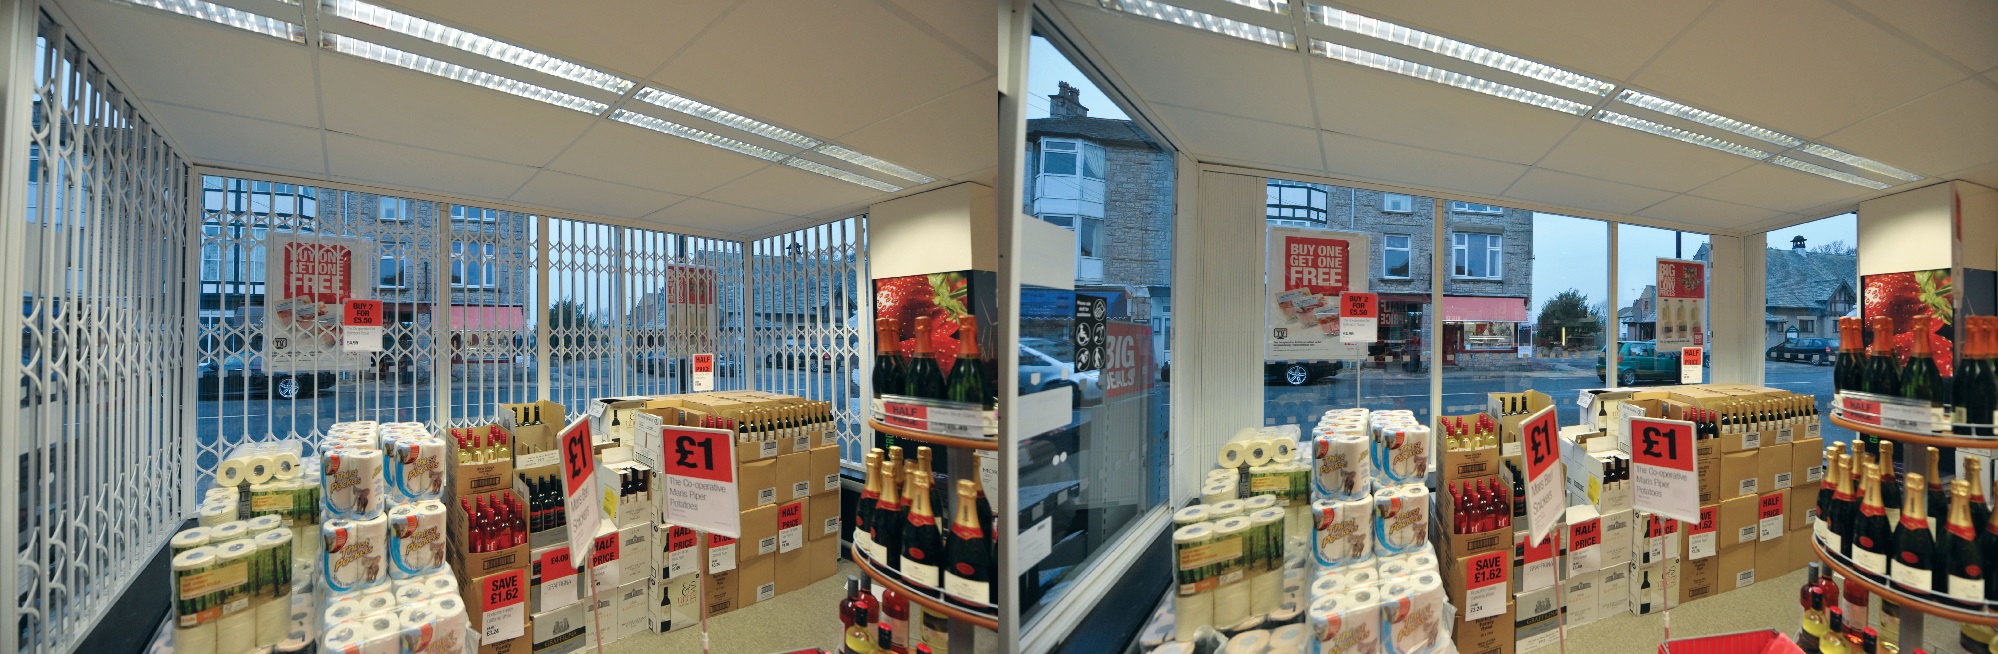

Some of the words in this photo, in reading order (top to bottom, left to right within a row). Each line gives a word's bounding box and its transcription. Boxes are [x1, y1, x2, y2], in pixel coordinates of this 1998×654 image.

[1290, 243, 1316, 255] BUY
[1317, 245, 1343, 257] ONE
[1289, 255, 1315, 267] GET
[1317, 257, 1343, 268] ONE
[1659, 262, 1676, 277] BIG
[290, 274, 344, 294] FREE
[1290, 267, 1343, 287] FREE
[1659, 280, 1676, 291] LOW
[1105, 335, 1136, 370] BIG
[1684, 349, 1700, 357] HALF
[893, 405, 918, 416] HALF
[1849, 401, 1872, 412] HALF
[1531, 420, 1551, 466] £1
[1642, 426, 1677, 460] £1
[569, 429, 587, 480] £1
[675, 435, 714, 471] £1
[1636, 465, 1648, 474] The
[1648, 467, 1688, 481] Co-operative
[669, 476, 682, 486] The
[683, 478, 726, 493] Co-operative
[1636, 475, 1653, 485] Maris
[1653, 478, 1670, 489] Piper
[669, 487, 688, 498] Maris
[689, 490, 707, 501] Piper
[1636, 486, 1662, 498] Potatoes
[670, 498, 699, 512] Potatoes
[1533, 490, 1553, 515] Snickers
[1762, 496, 1780, 508] HALF
[781, 506, 799, 517] HALF
[1763, 508, 1780, 518] PRICE
[782, 519, 799, 529] PRICE
[1575, 522, 1597, 536] HALF
[673, 538, 693, 551] PRICE
[1575, 536, 1597, 550] PRICE
[550, 553, 569, 565] £4.09
[593, 552, 615, 567] PRICE
[1475, 556, 1501, 571] SAVE
[1474, 568, 1502, 583] £1.62
[491, 575, 518, 592] SAVE
[490, 588, 518, 605] £1.62
[544, 630, 578, 647] GRAFFIGNA
